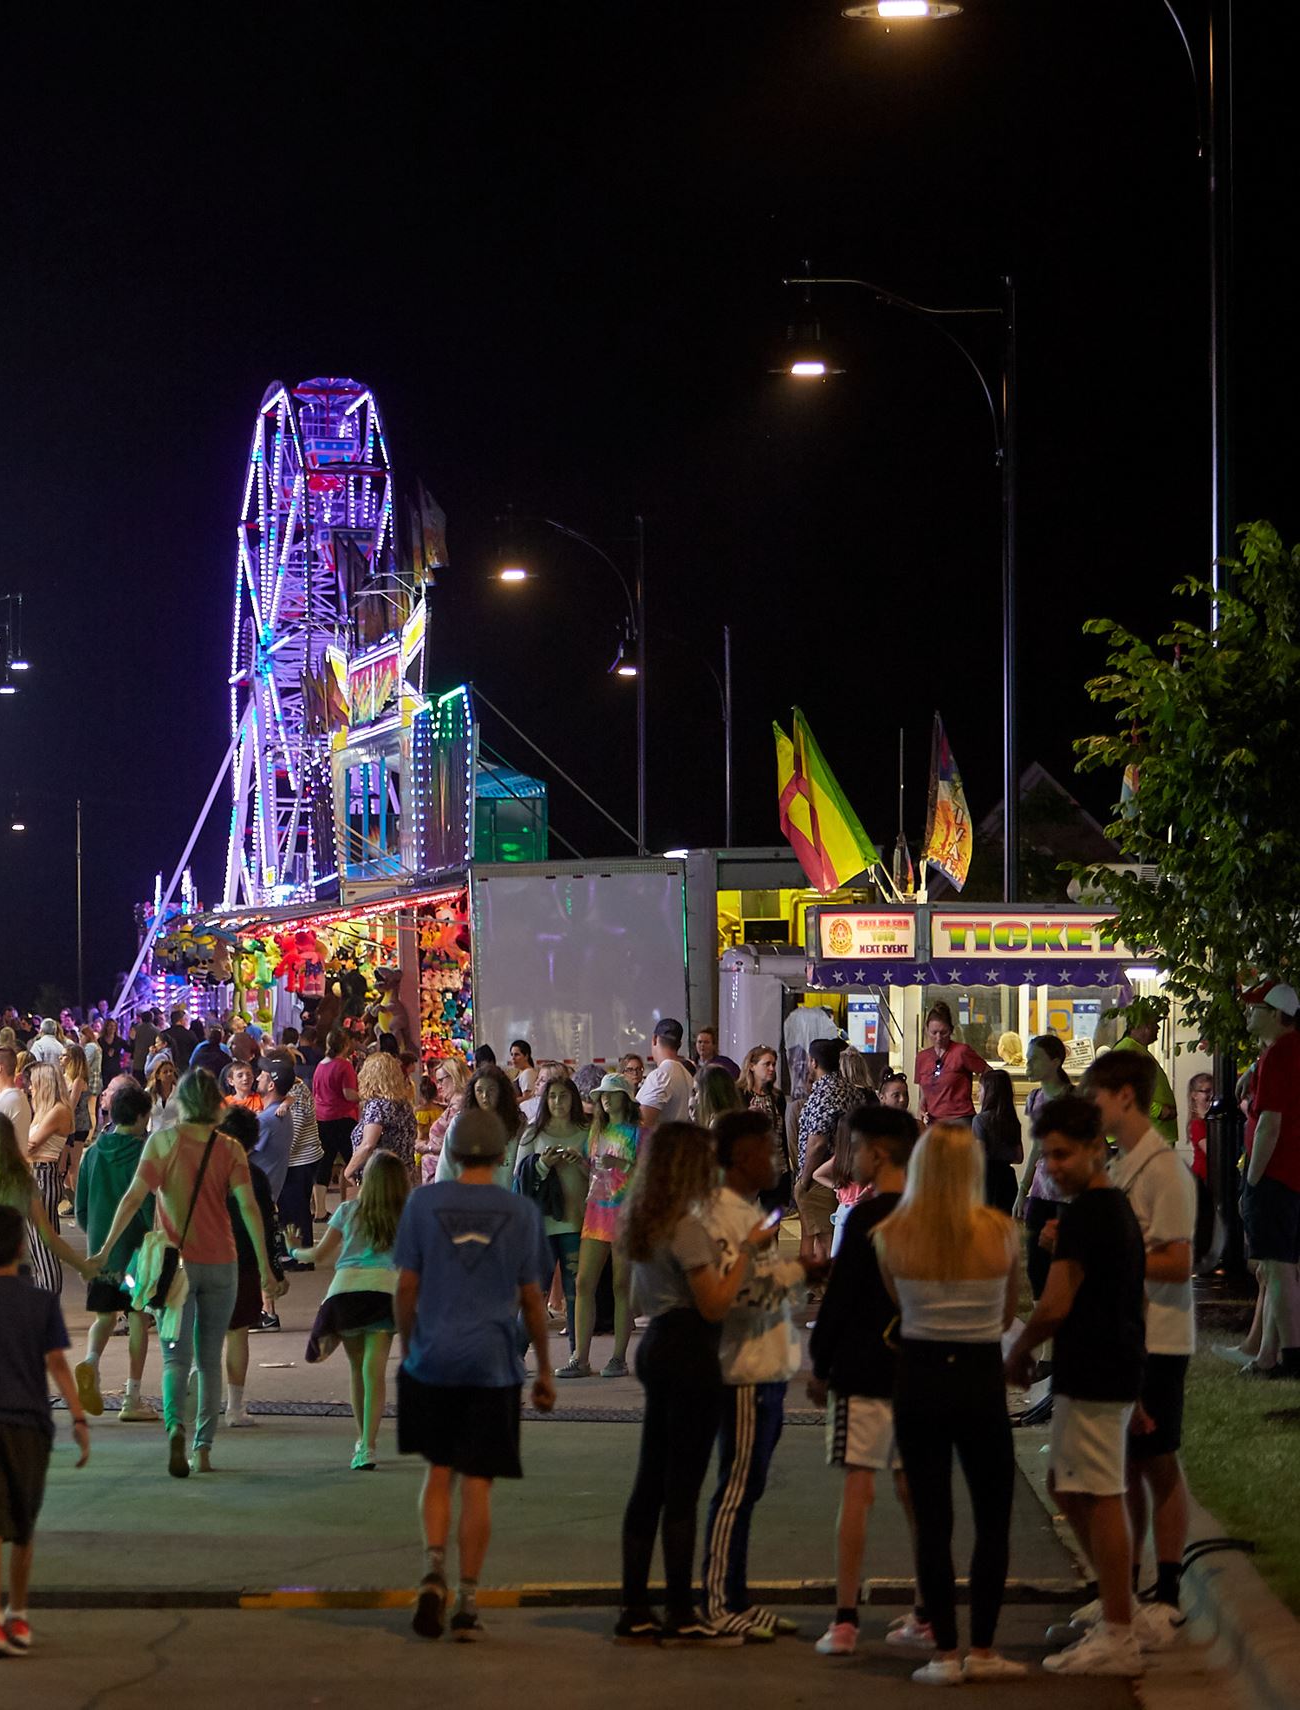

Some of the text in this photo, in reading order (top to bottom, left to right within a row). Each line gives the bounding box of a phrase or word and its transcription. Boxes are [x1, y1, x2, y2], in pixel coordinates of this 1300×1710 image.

[941, 921, 1158, 952] TICKET
[859, 944, 908, 954] NEXT EVENT
